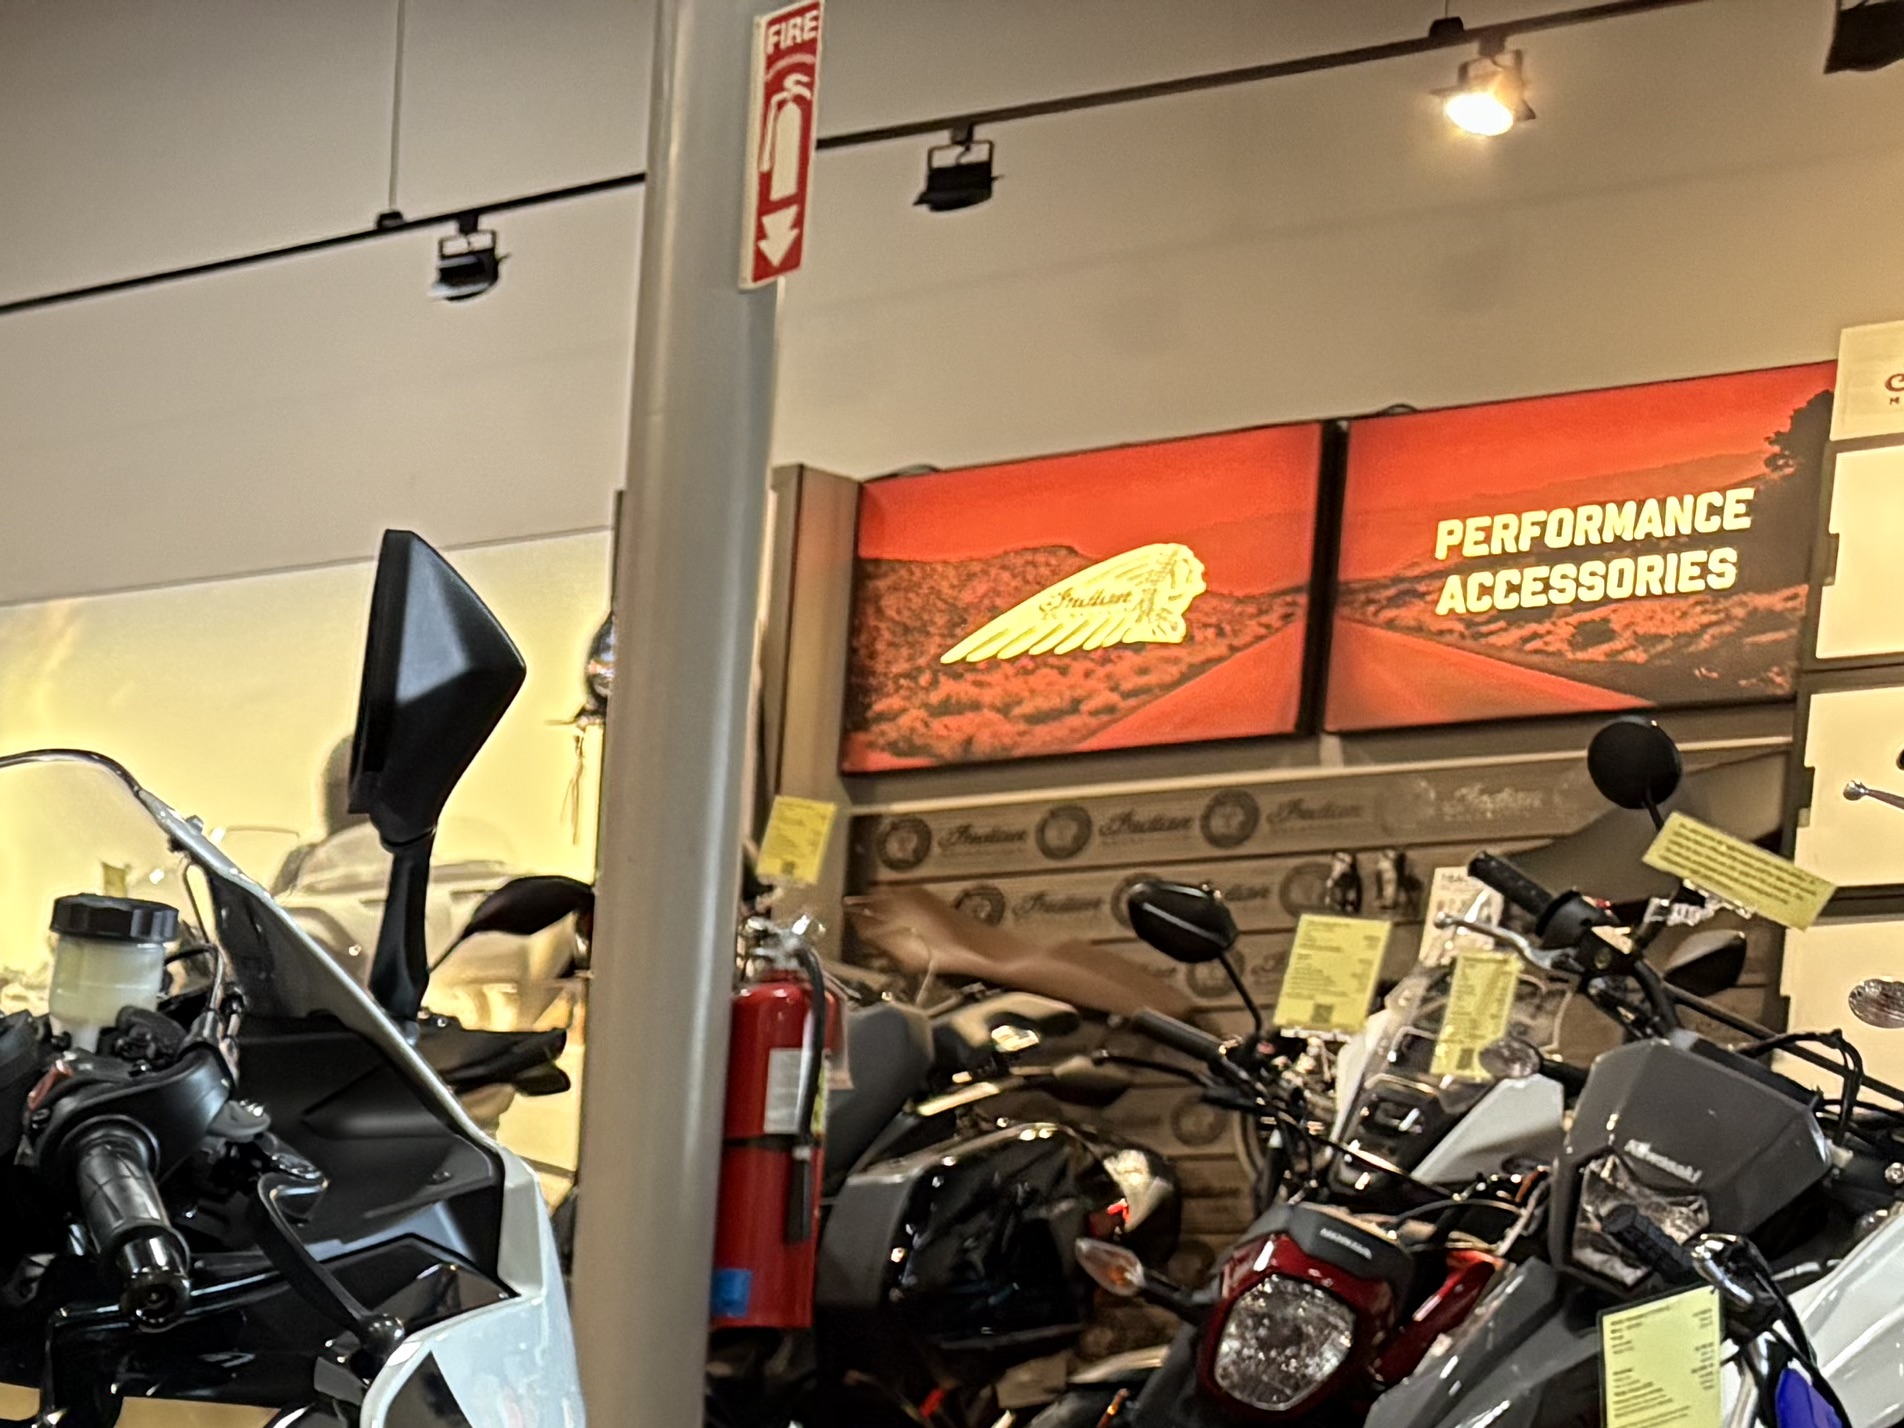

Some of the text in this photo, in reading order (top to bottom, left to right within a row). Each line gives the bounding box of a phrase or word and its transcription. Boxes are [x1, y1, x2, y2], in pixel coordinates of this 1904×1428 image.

[766, 10, 818, 55] FIRE
[1435, 487, 1755, 560] PERFORMANCE
[1435, 547, 1738, 615] ACCESSORIES
